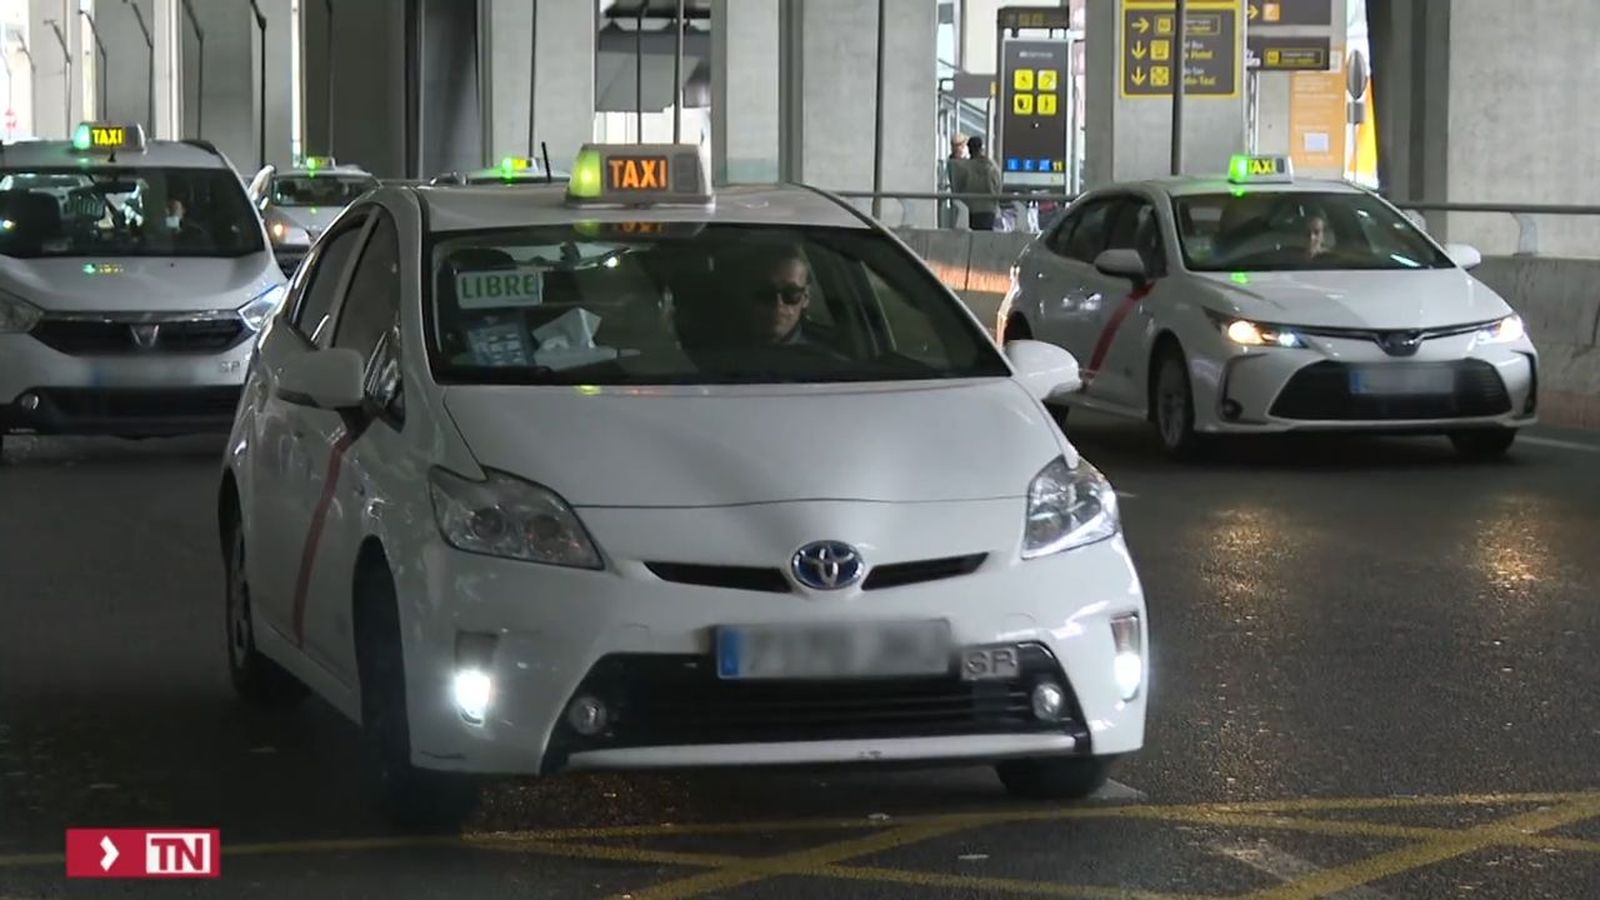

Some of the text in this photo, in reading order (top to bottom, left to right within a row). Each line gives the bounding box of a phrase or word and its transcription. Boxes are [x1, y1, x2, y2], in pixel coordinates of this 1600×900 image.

[91, 128, 123, 145] TAXI
[608, 159, 667, 189] TAXI
[460, 274, 538, 299] LIBRE
[220, 360, 241, 374] SP
[965, 650, 1017, 676] SP
